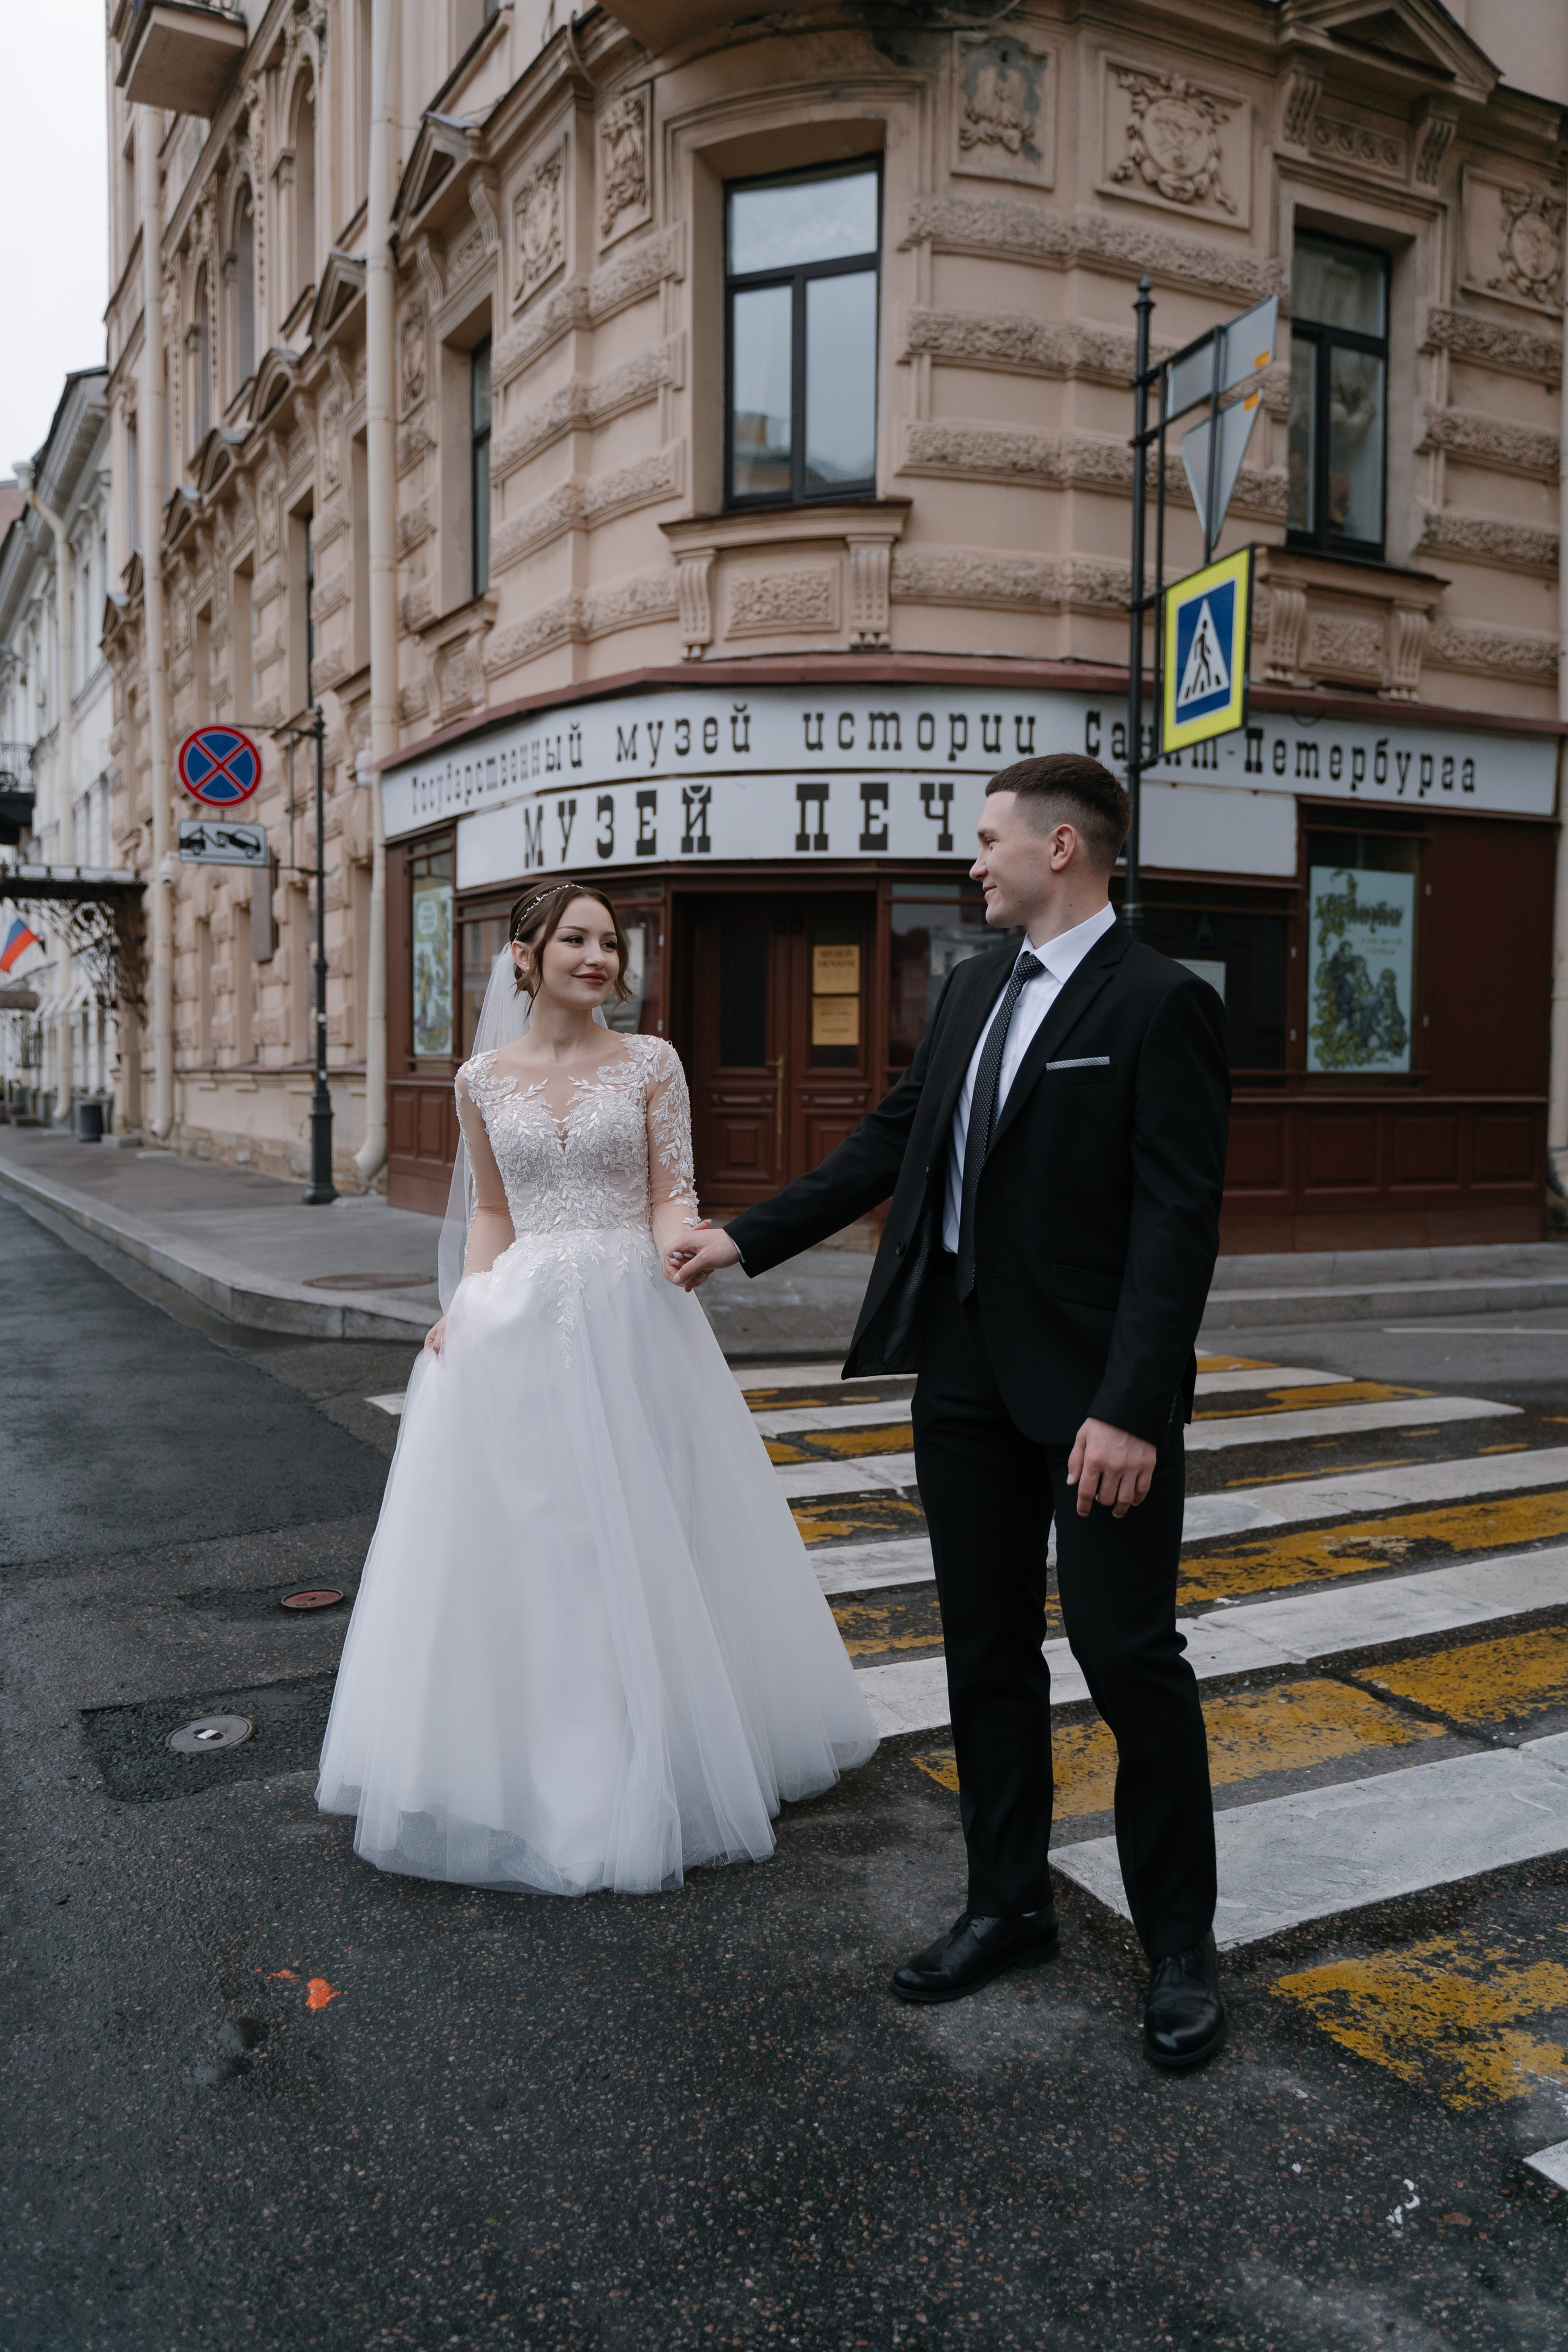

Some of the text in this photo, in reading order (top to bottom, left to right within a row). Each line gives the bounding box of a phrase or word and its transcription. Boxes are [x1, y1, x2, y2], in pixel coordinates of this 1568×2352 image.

[412, 703, 1476, 814] Государственный музей истории Сант-Петербурга
[524, 783, 954, 869] МУЗЕЙ ПЕЧ
